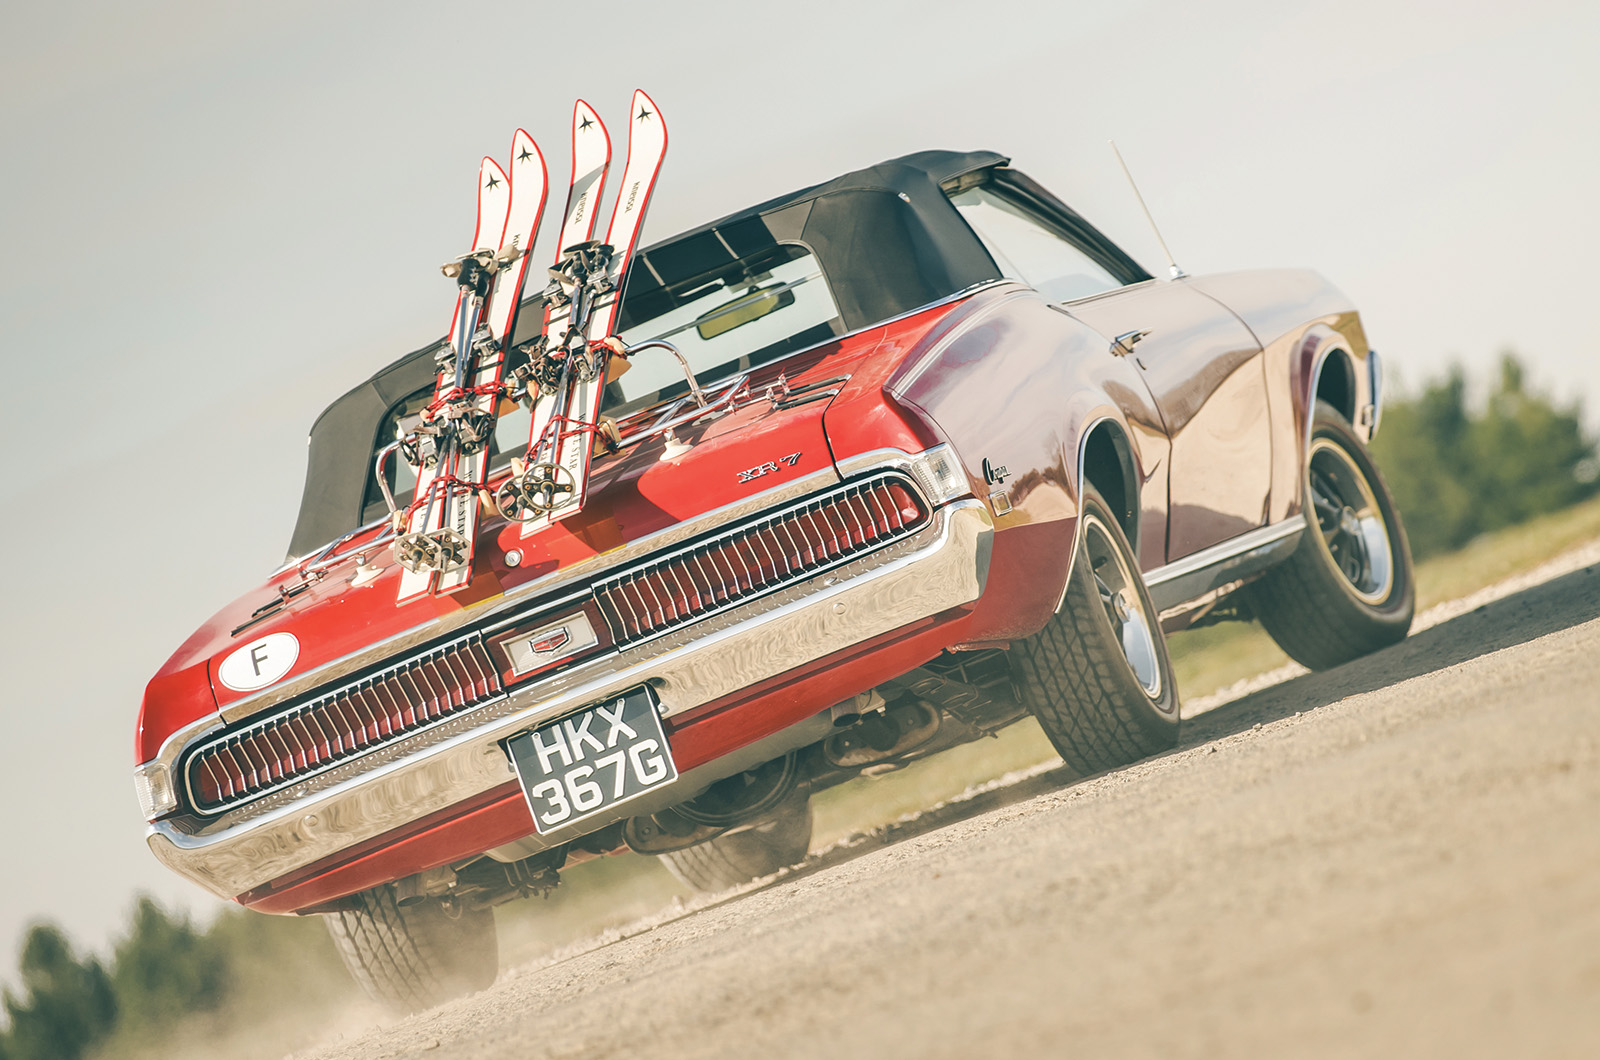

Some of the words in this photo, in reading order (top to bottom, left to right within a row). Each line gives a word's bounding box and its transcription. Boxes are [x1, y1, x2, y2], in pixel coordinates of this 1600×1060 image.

[569, 447, 580, 470] STAR
[251, 643, 268, 676] F
[531, 698, 638, 775] HKX
[532, 738, 667, 825] 367G
